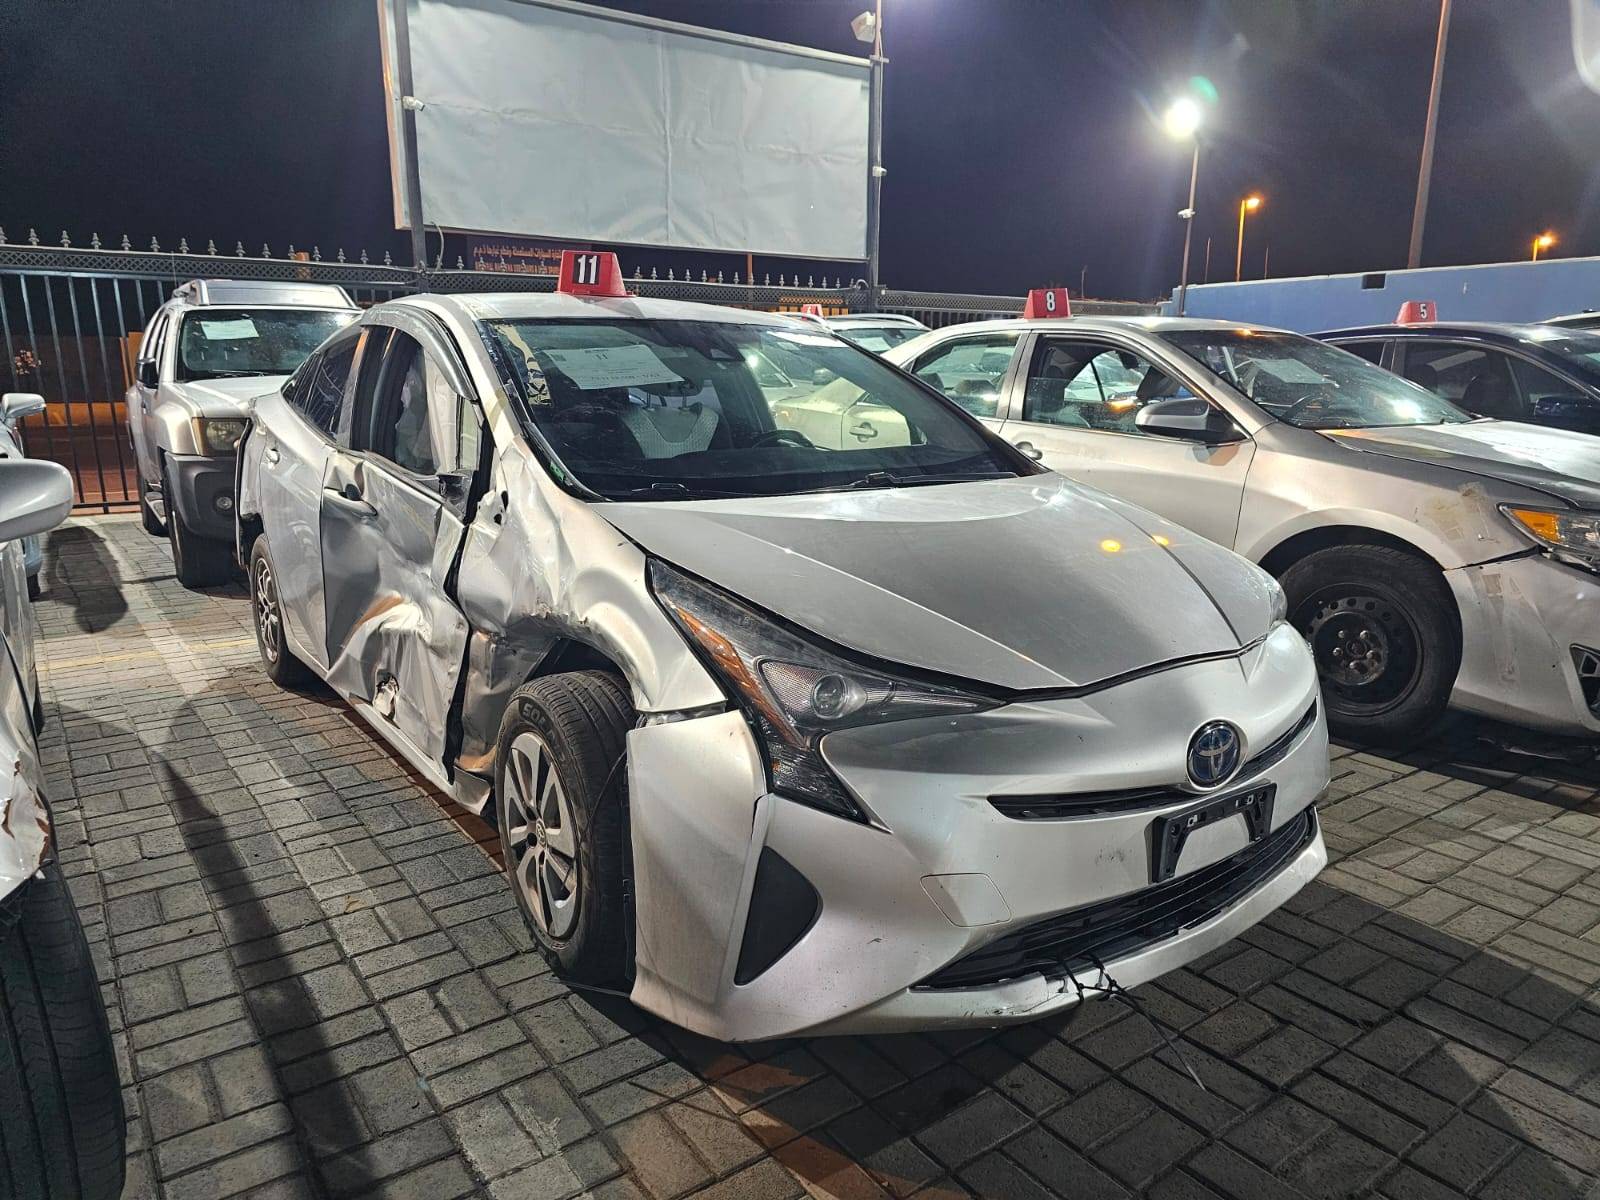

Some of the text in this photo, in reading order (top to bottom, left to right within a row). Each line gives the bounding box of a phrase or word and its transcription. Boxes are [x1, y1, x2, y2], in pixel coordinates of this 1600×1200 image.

[577, 254, 598, 284] 11
[1046, 291, 1055, 311] 8
[1420, 304, 1427, 319] 5
